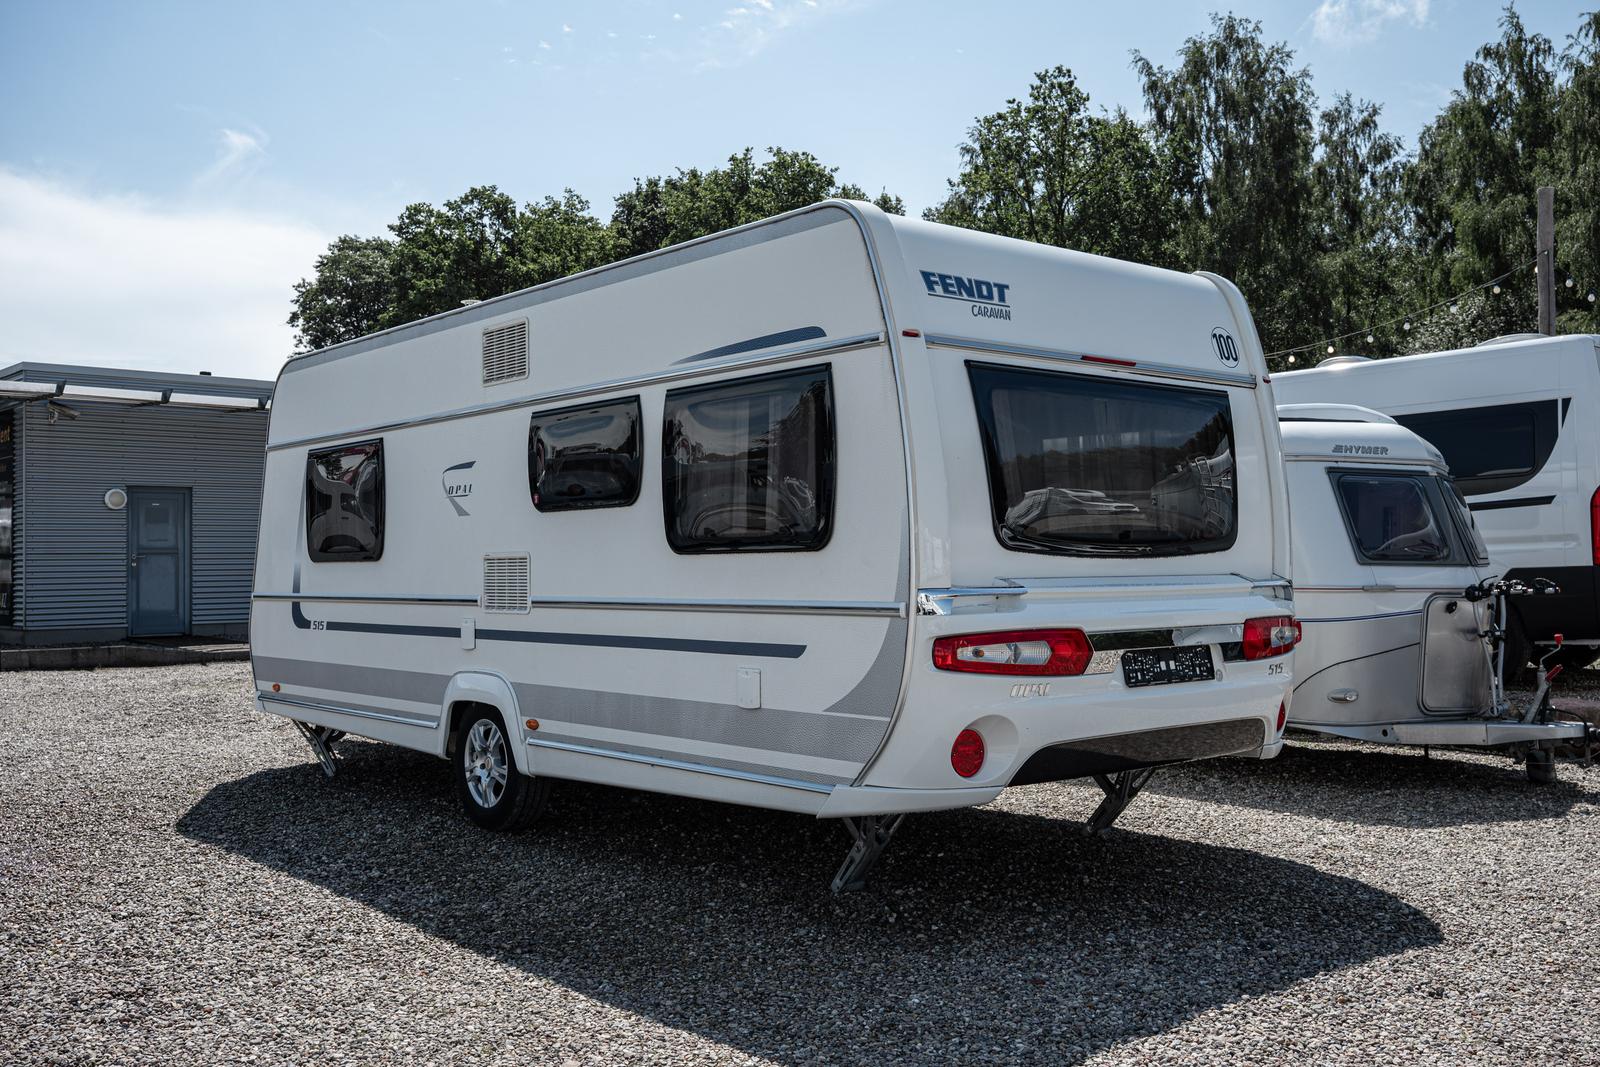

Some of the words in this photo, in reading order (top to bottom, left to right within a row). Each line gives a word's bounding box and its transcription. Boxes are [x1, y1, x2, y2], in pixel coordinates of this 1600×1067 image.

[919, 269, 1009, 304] FENDT
[971, 304, 1011, 321] CARAVAN
[1212, 333, 1239, 362] 100
[1342, 444, 1389, 456] HYMER
[312, 620, 325, 631] 515
[1268, 662, 1284, 676] 515
